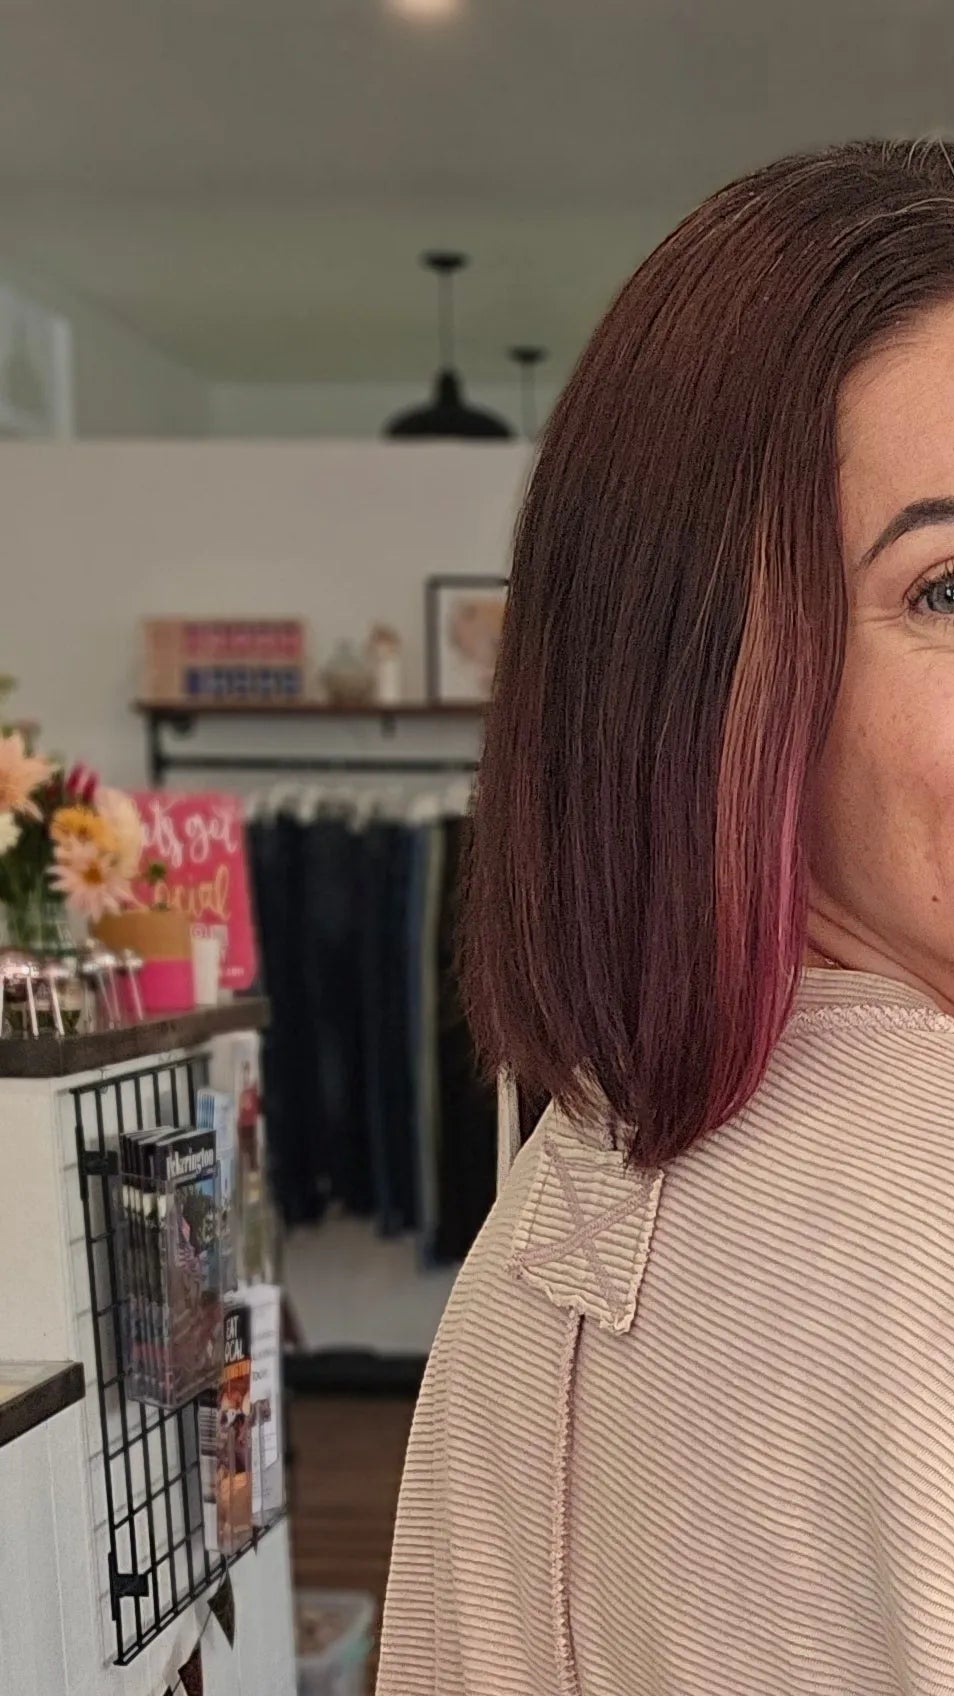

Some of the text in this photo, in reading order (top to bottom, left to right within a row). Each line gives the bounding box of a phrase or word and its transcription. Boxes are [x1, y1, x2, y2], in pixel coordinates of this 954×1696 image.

[185, 808, 238, 863] get
[153, 863, 231, 921] ocial
[225, 1315, 240, 1340] EAT
